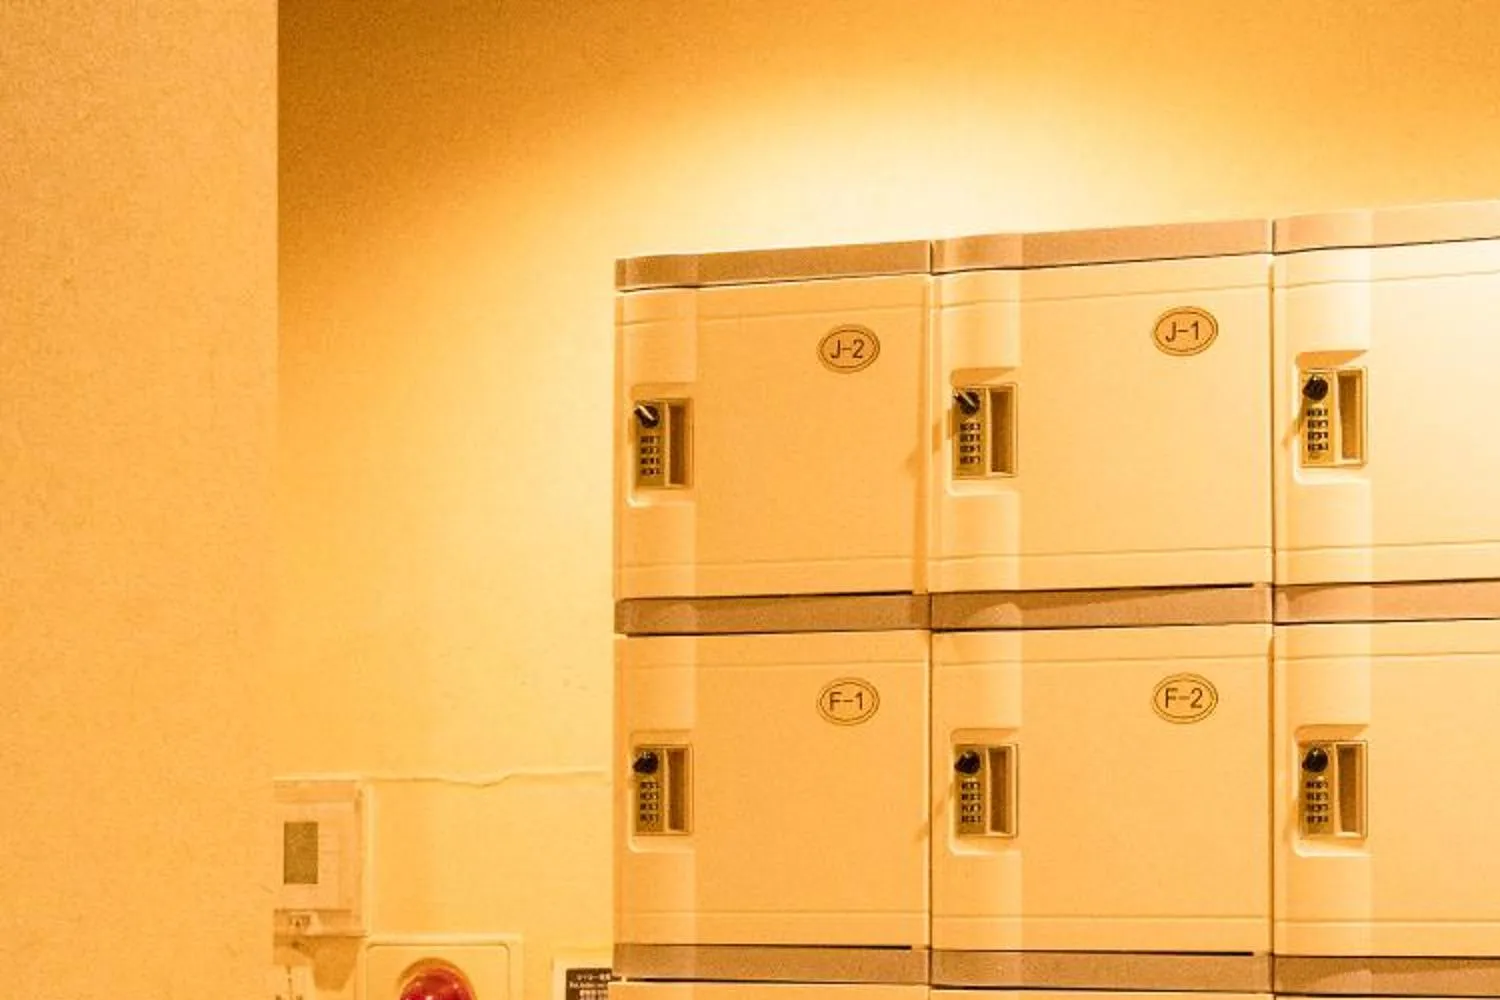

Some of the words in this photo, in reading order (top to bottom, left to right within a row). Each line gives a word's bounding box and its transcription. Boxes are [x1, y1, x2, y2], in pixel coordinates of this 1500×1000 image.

[1165, 320, 1200, 343] J-1
[830, 339, 865, 360] J-2
[829, 690, 864, 711] F-1
[1165, 688, 1204, 709] F-2
